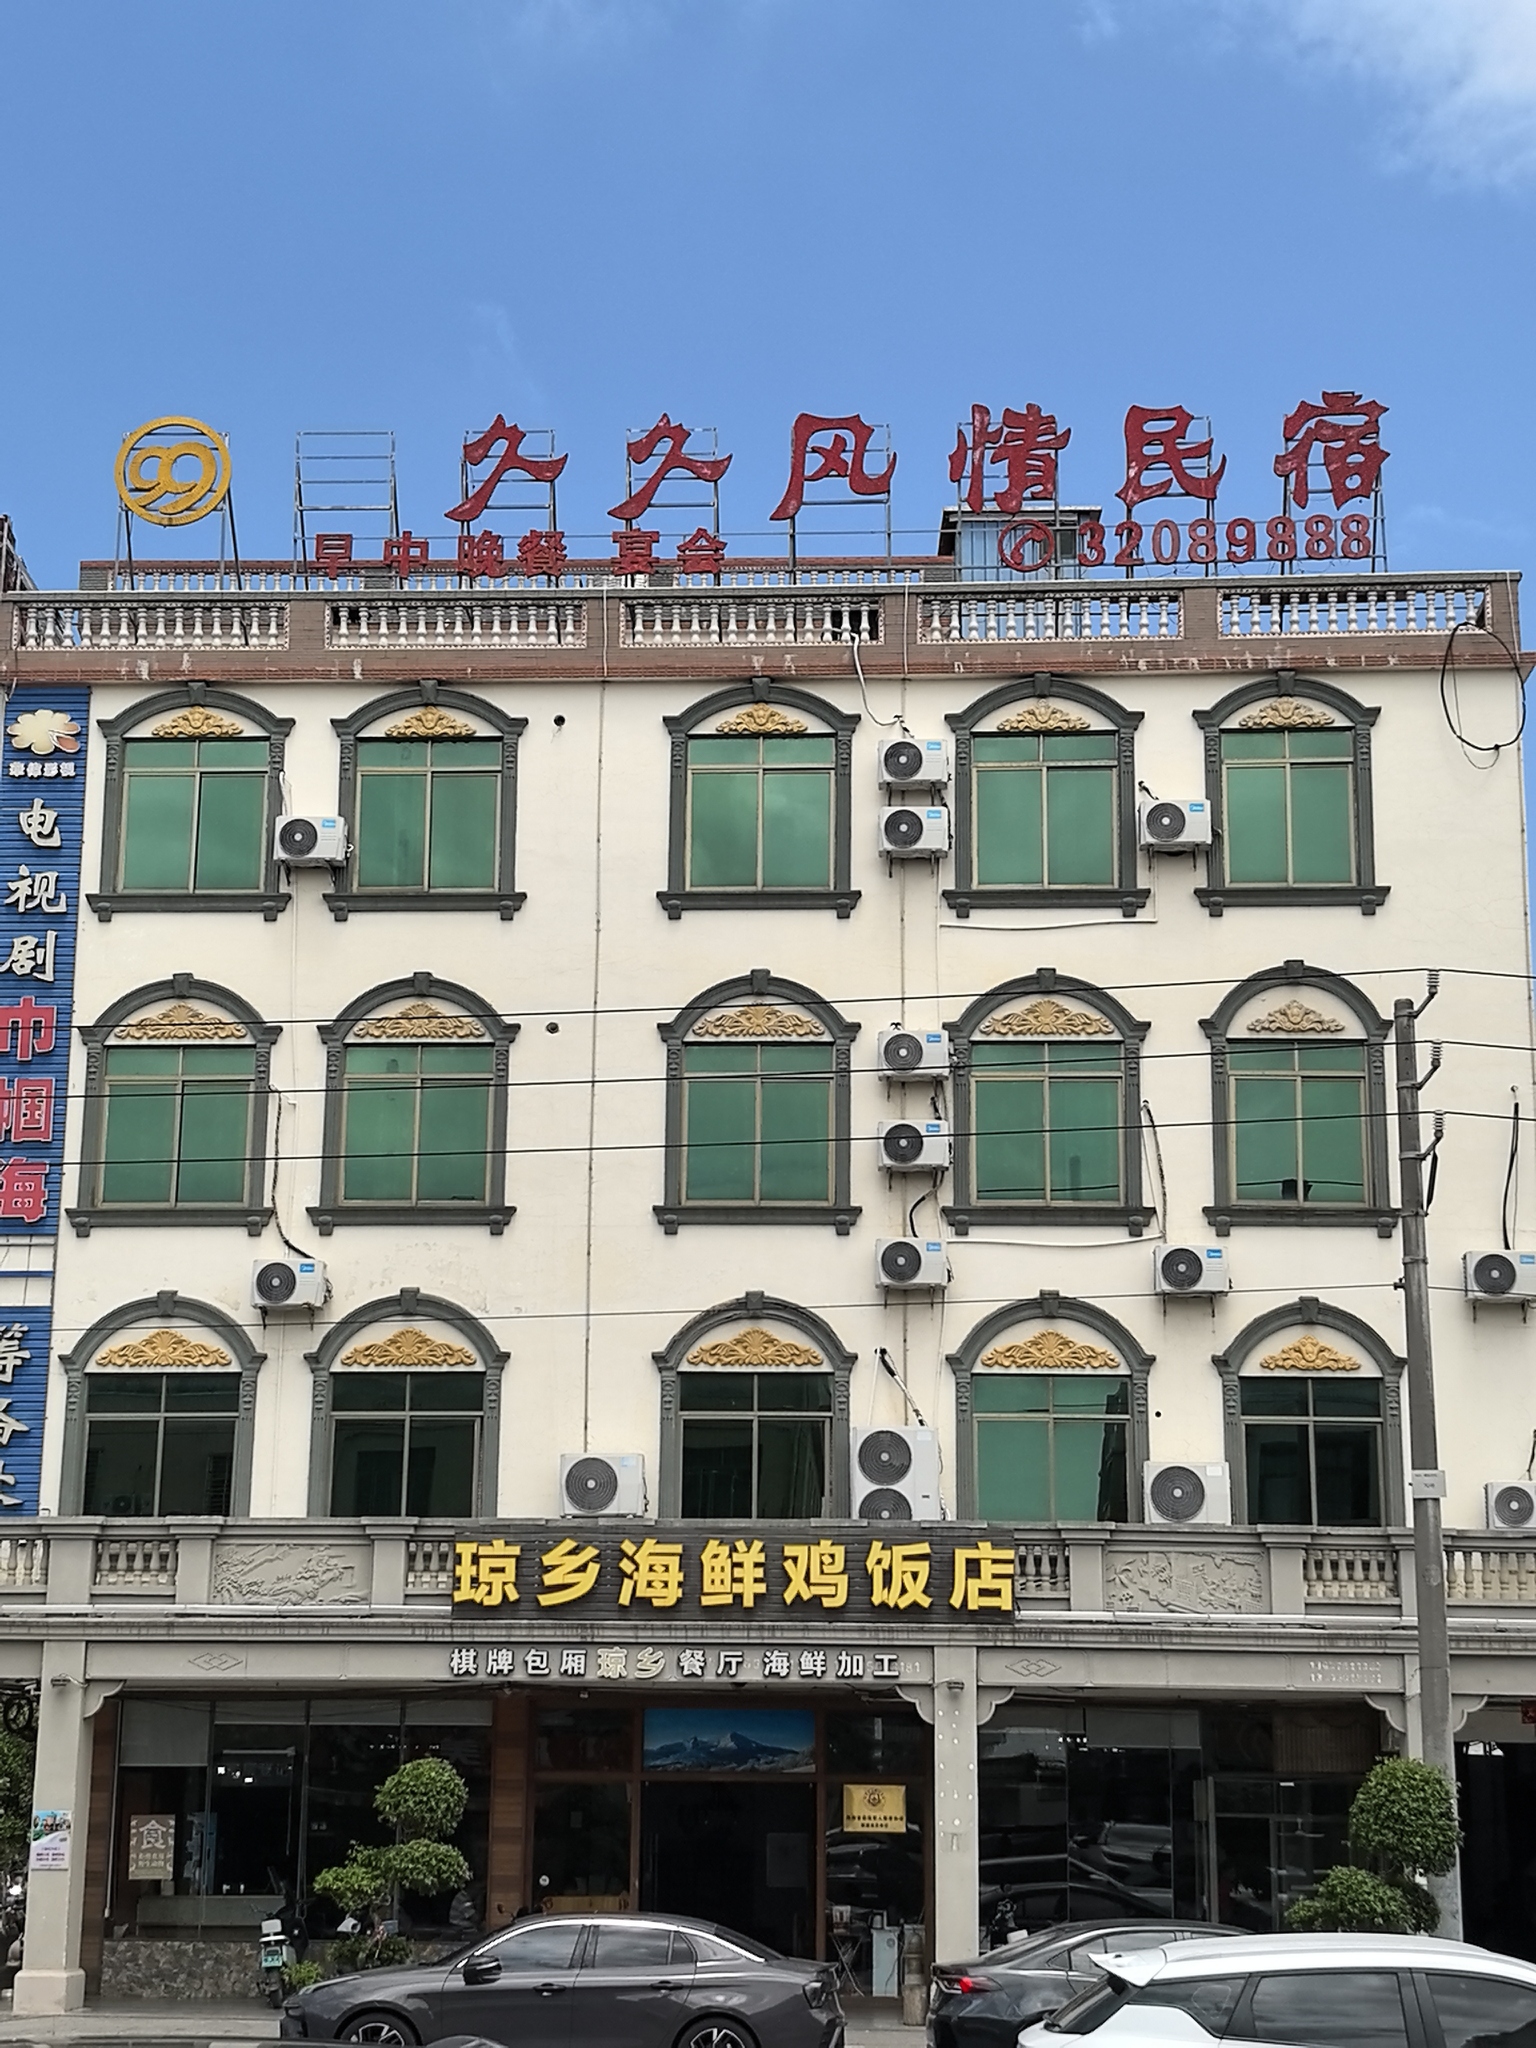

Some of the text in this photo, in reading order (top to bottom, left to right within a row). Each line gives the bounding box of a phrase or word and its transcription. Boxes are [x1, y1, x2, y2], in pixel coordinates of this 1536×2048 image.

[445, 391, 1391, 521] 久久风情民宿
[1078, 513, 1372, 568] 32089888
[453, 1538, 1015, 1612] 琼乡海鲜鸡饭店
